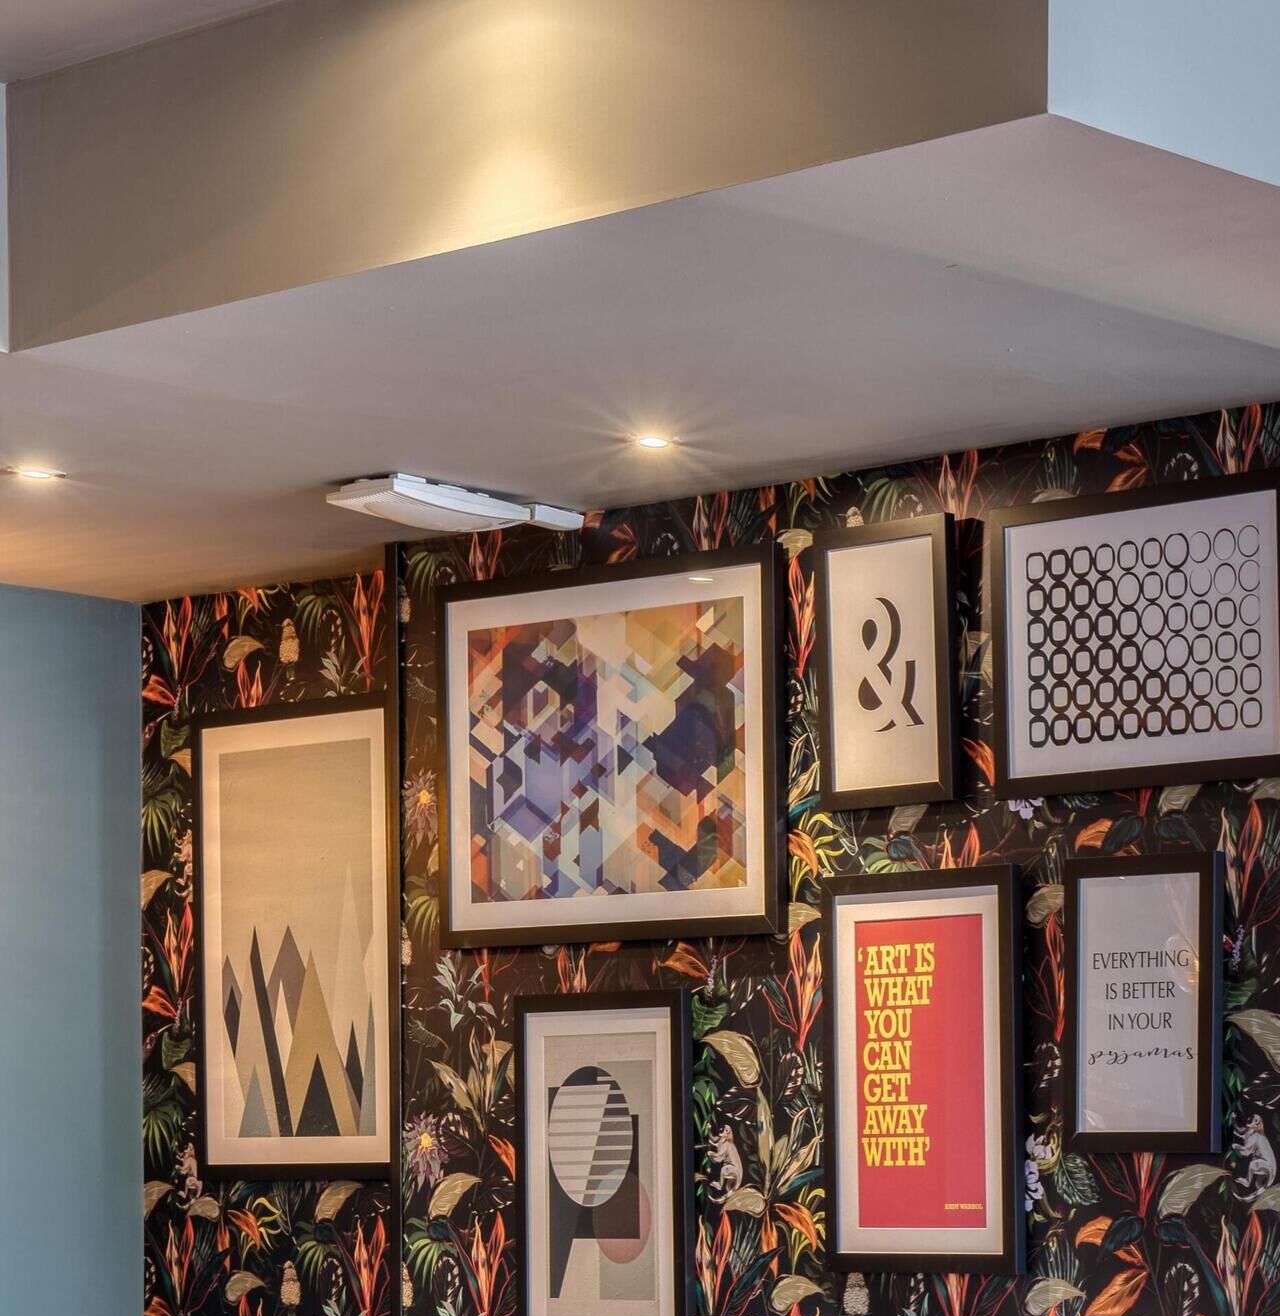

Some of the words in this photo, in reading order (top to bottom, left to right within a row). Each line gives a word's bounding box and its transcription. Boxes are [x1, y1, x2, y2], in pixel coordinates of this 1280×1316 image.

[914, 942, 936, 973] IS
[1092, 948, 1190, 970] EVERYTHING
[864, 975, 932, 1007] WHAT
[1105, 980, 1118, 1001] IS
[1121, 980, 1176, 1000] BETTER
[863, 1008, 912, 1041] YOU
[1108, 1012, 1125, 1031] IN
[1127, 1012, 1173, 1031] YOUR
[863, 1040, 912, 1072] CAN
[1087, 1043, 1195, 1067] pyjamas
[863, 1073, 911, 1104] GET
[863, 1104, 928, 1136] AWAY
